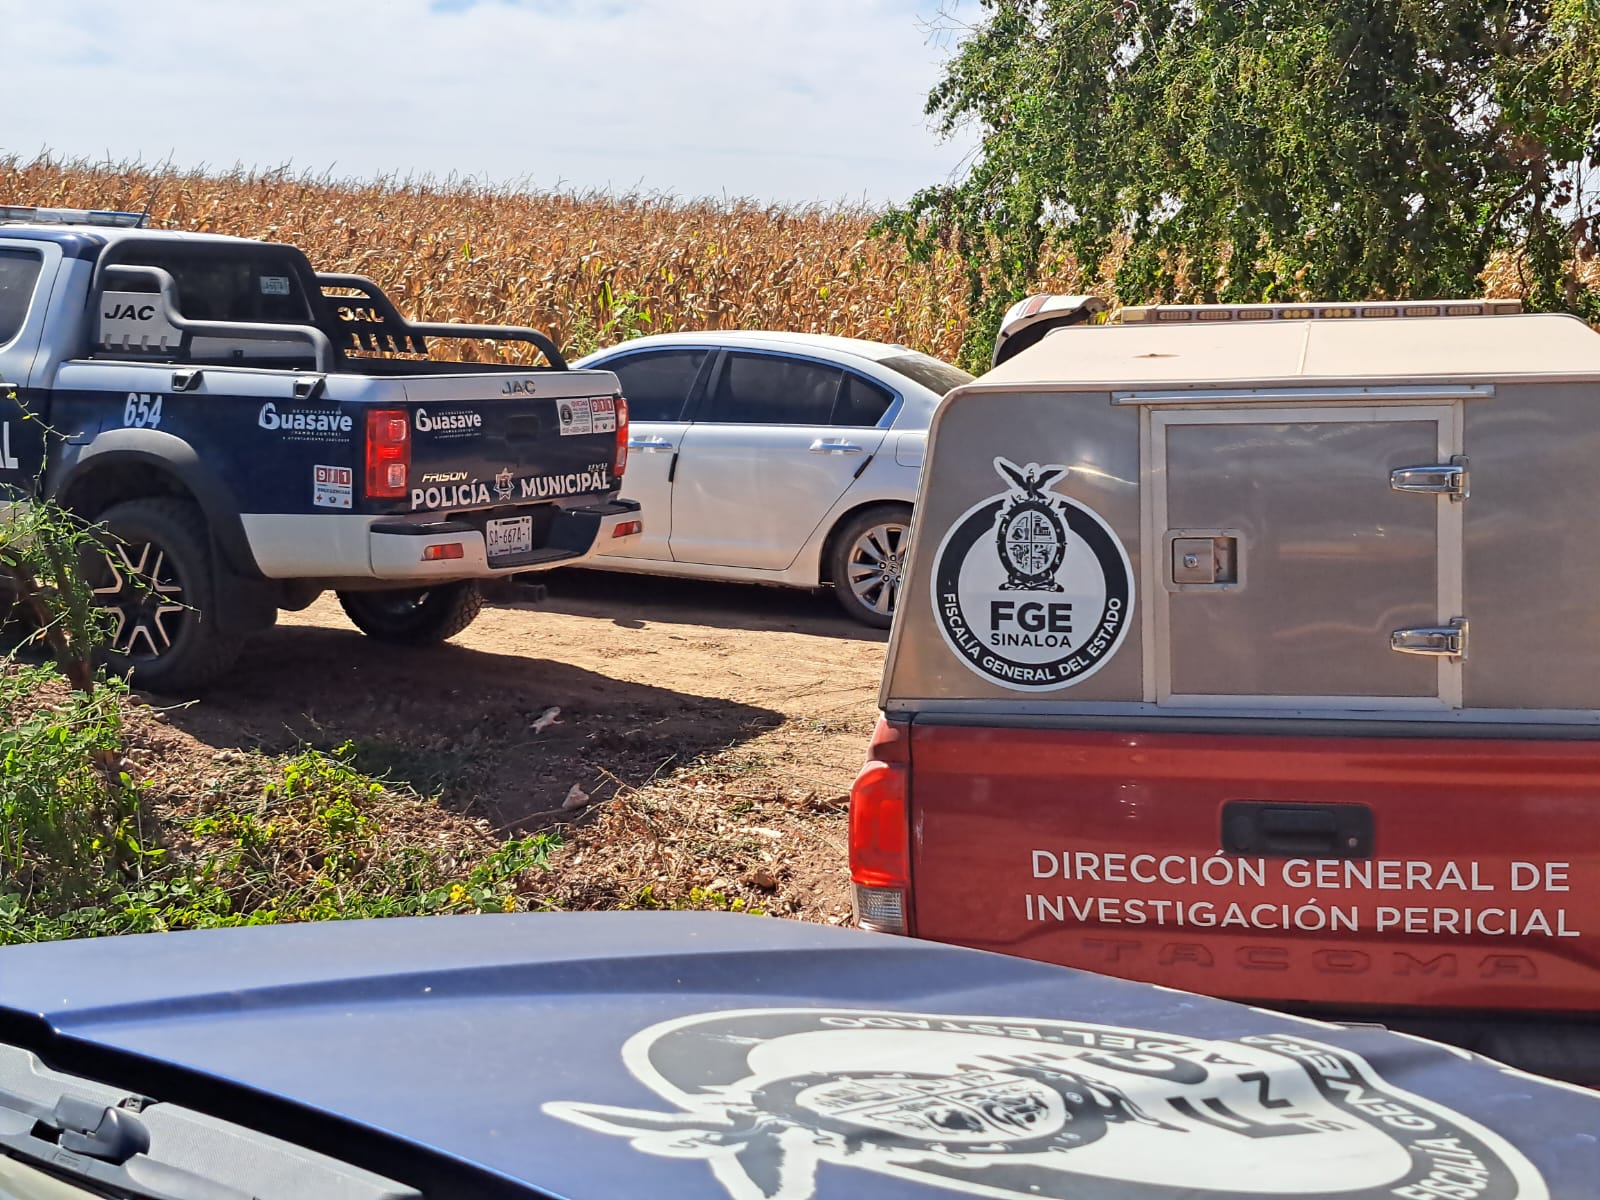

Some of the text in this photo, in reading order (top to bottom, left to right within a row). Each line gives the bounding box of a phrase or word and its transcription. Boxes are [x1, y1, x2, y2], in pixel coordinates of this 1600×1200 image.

[105, 304, 155, 321] JAC
[501, 380, 536, 395] JAC
[123, 392, 163, 429] 654
[258, 402, 353, 432] Guasave
[592, 399, 612, 411] 911
[415, 408, 482, 432] Guasave
[317, 469, 348, 483] 911
[421, 471, 468, 483] FRISON
[411, 471, 611, 509] POLICÍA MUNICIPAL
[990, 600, 1073, 634] FGE
[943, 592, 1122, 681] FISCALÍA GENERAL DEL ESTADO
[990, 633, 1072, 649] SINALOA
[1031, 850, 1570, 892] DIRECCIÓN GENERAL DE
[1025, 894, 1581, 938] INVESTIGACIÓN PERICIAL
[1080, 937, 1538, 979] TACOMA
[820, 1016, 1042, 1041] ESTADO
